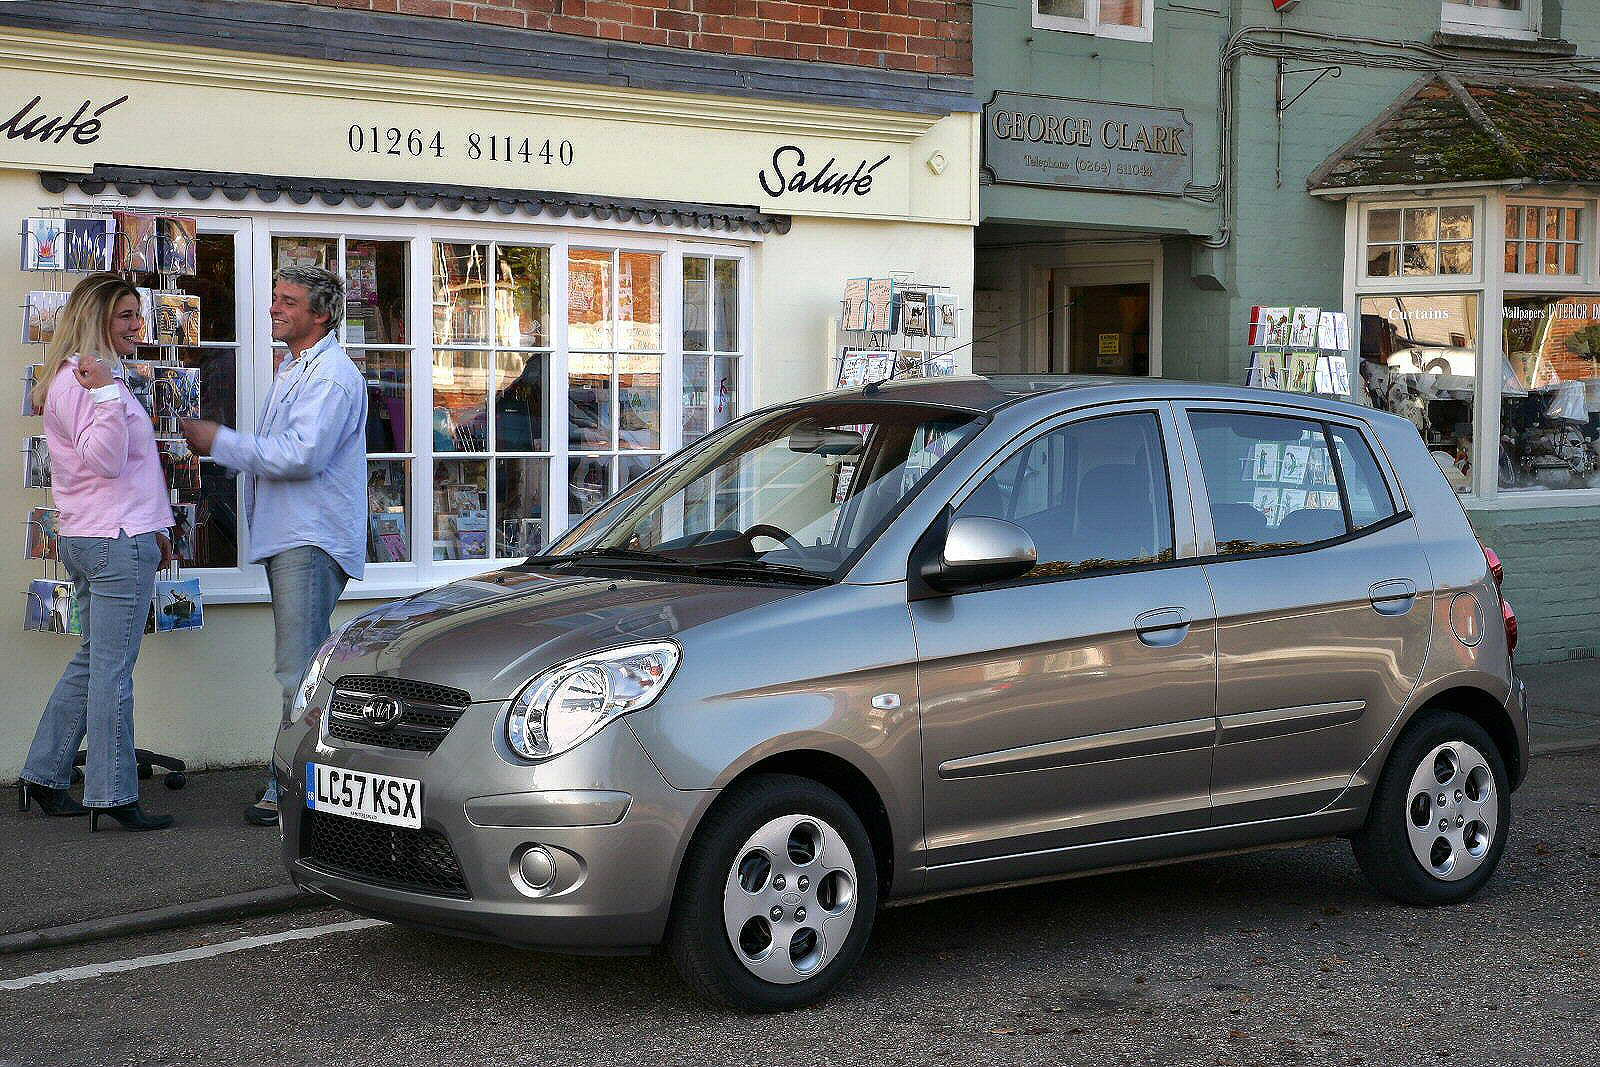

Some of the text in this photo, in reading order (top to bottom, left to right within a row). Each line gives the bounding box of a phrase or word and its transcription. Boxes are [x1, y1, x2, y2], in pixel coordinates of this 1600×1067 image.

[348, 124, 574, 166] 01264 811440
[992, 110, 1186, 156] GEORGE CLARK
[758, 145, 890, 198] Saluté
[1388, 307, 1449, 321] Curtains
[1502, 306, 1546, 321] Wallpapers
[1548, 303, 1588, 320] INTERIOR
[317, 767, 417, 819] LC57 KSX
